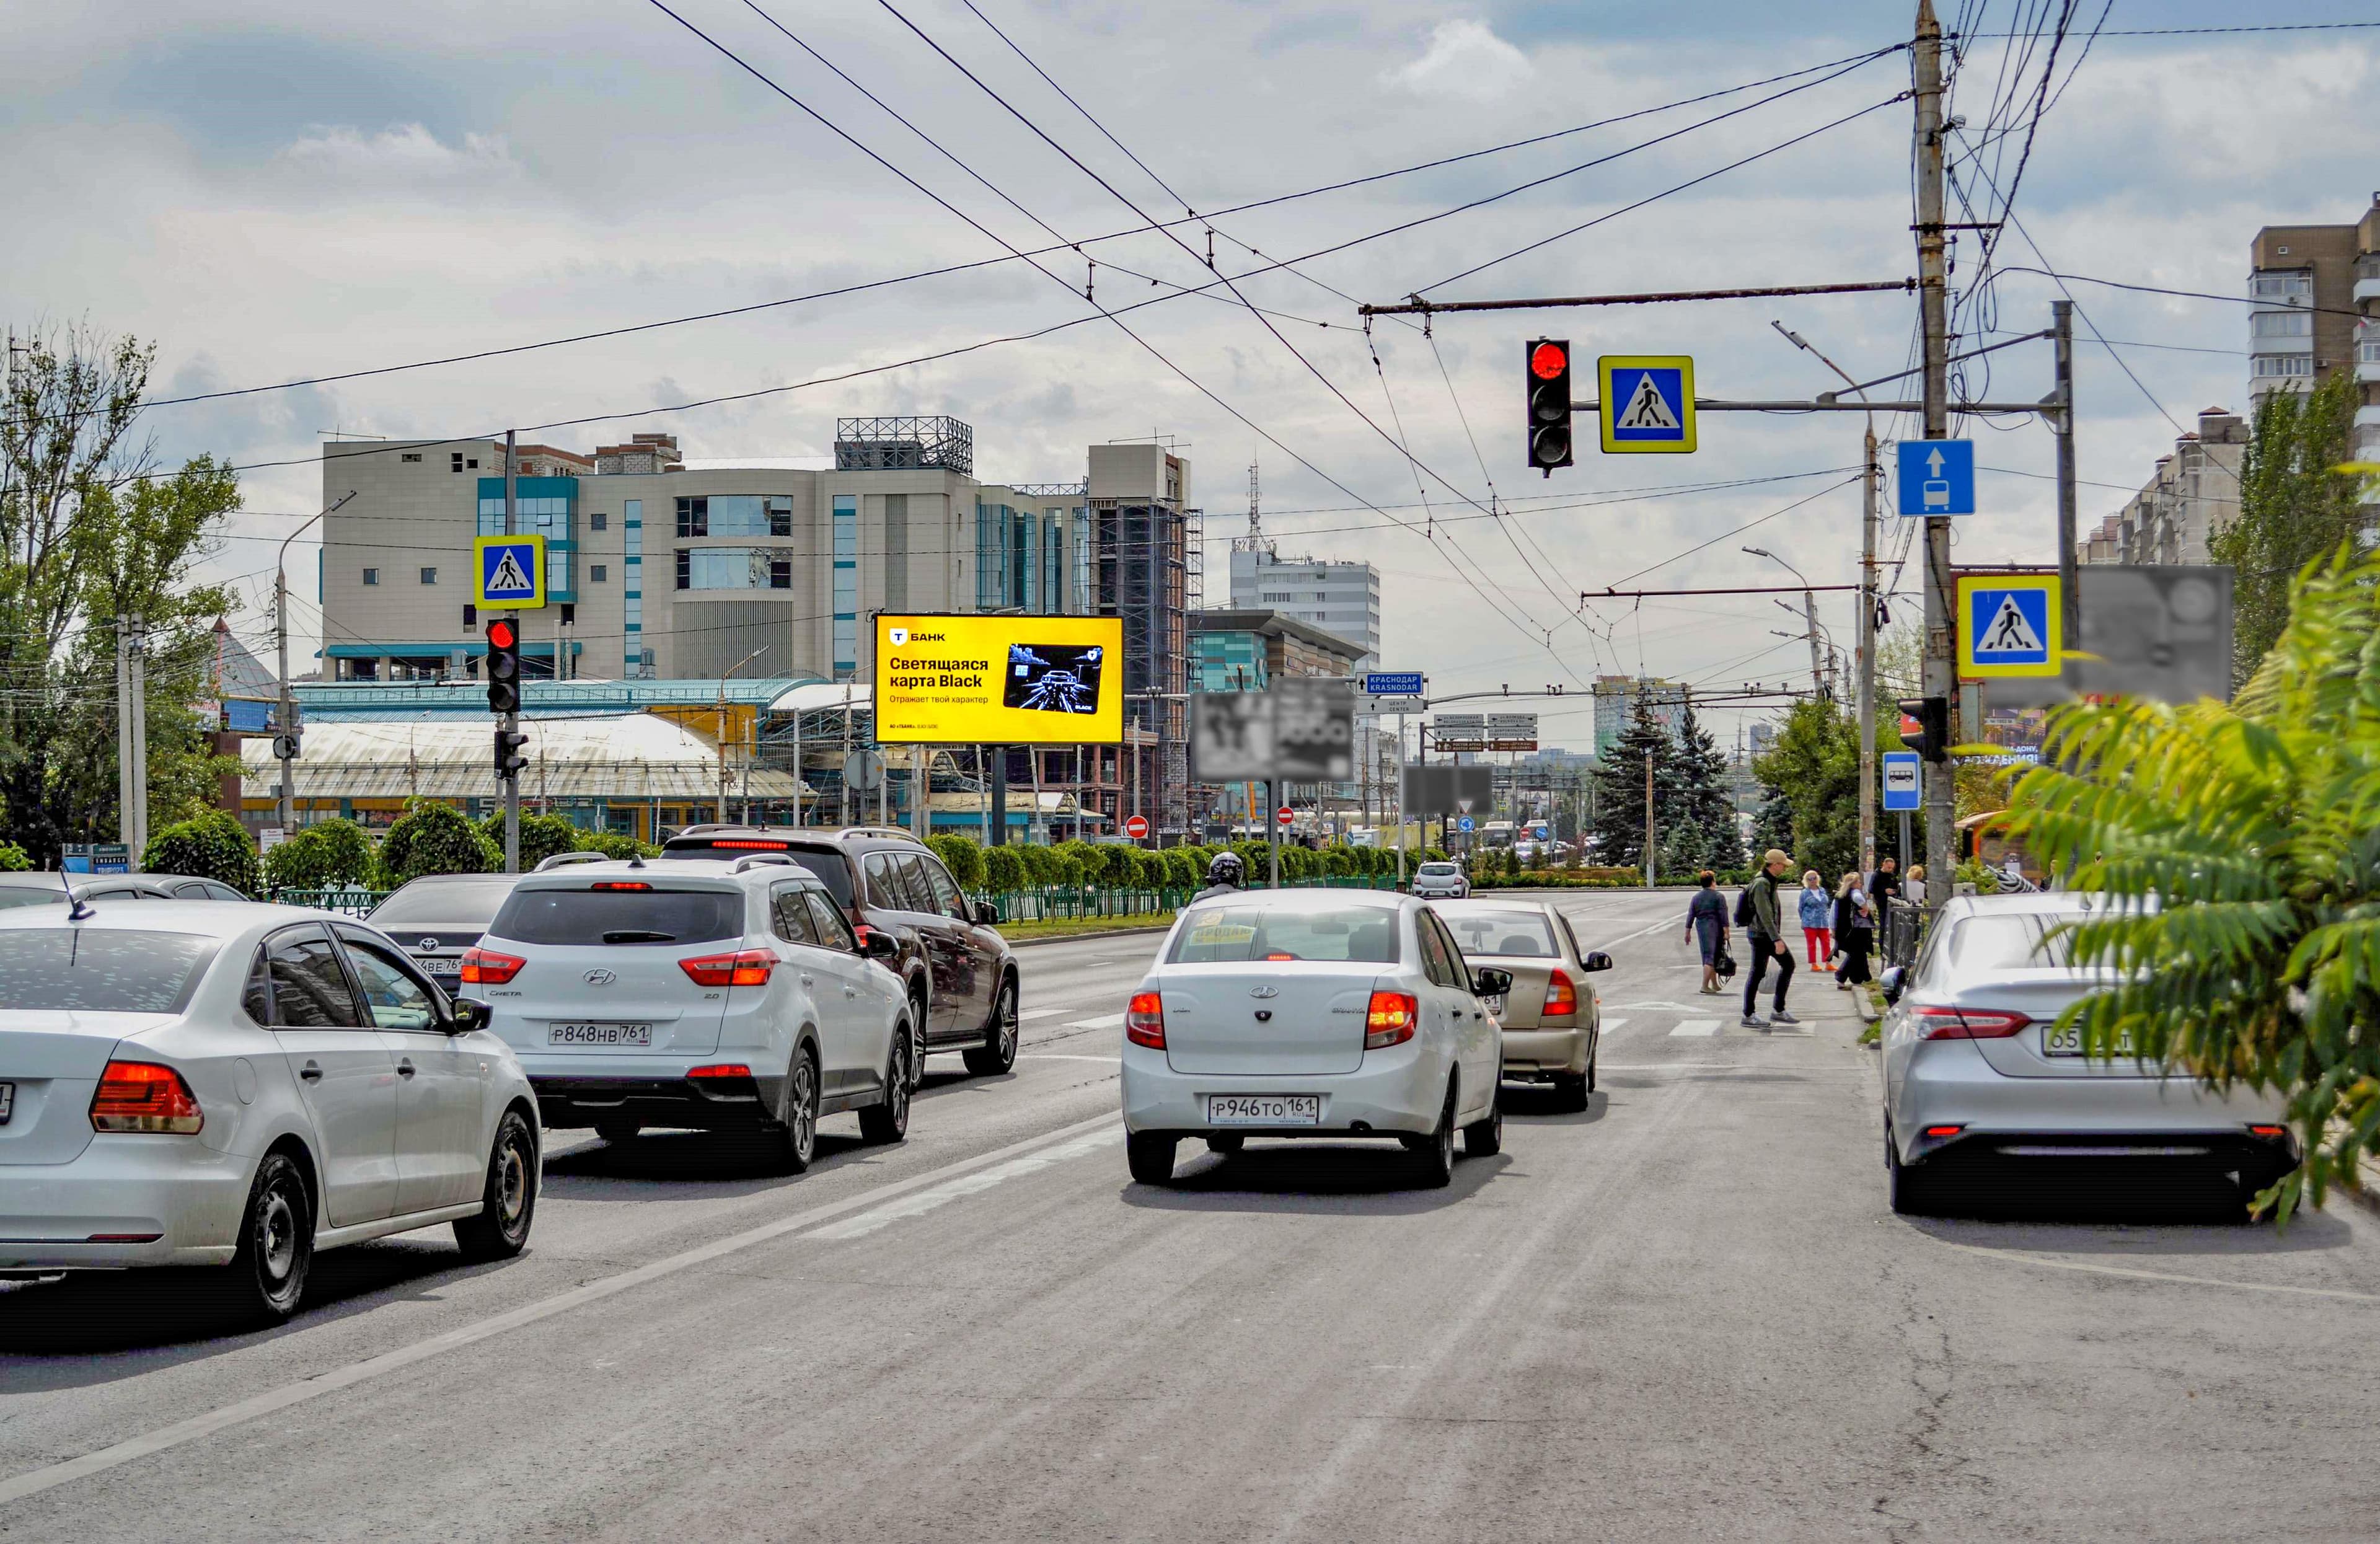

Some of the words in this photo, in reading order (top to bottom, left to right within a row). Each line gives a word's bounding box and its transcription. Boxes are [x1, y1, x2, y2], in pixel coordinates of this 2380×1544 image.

[910, 633, 945, 642] БАНК
[890, 657, 989, 672] Светящаяся
[890, 676, 935, 690] карта
[940, 674, 982, 687] Black
[889, 695, 929, 704] Отражает
[622, 1025, 646, 1039] 761
[1287, 1098, 1313, 1112] 161
